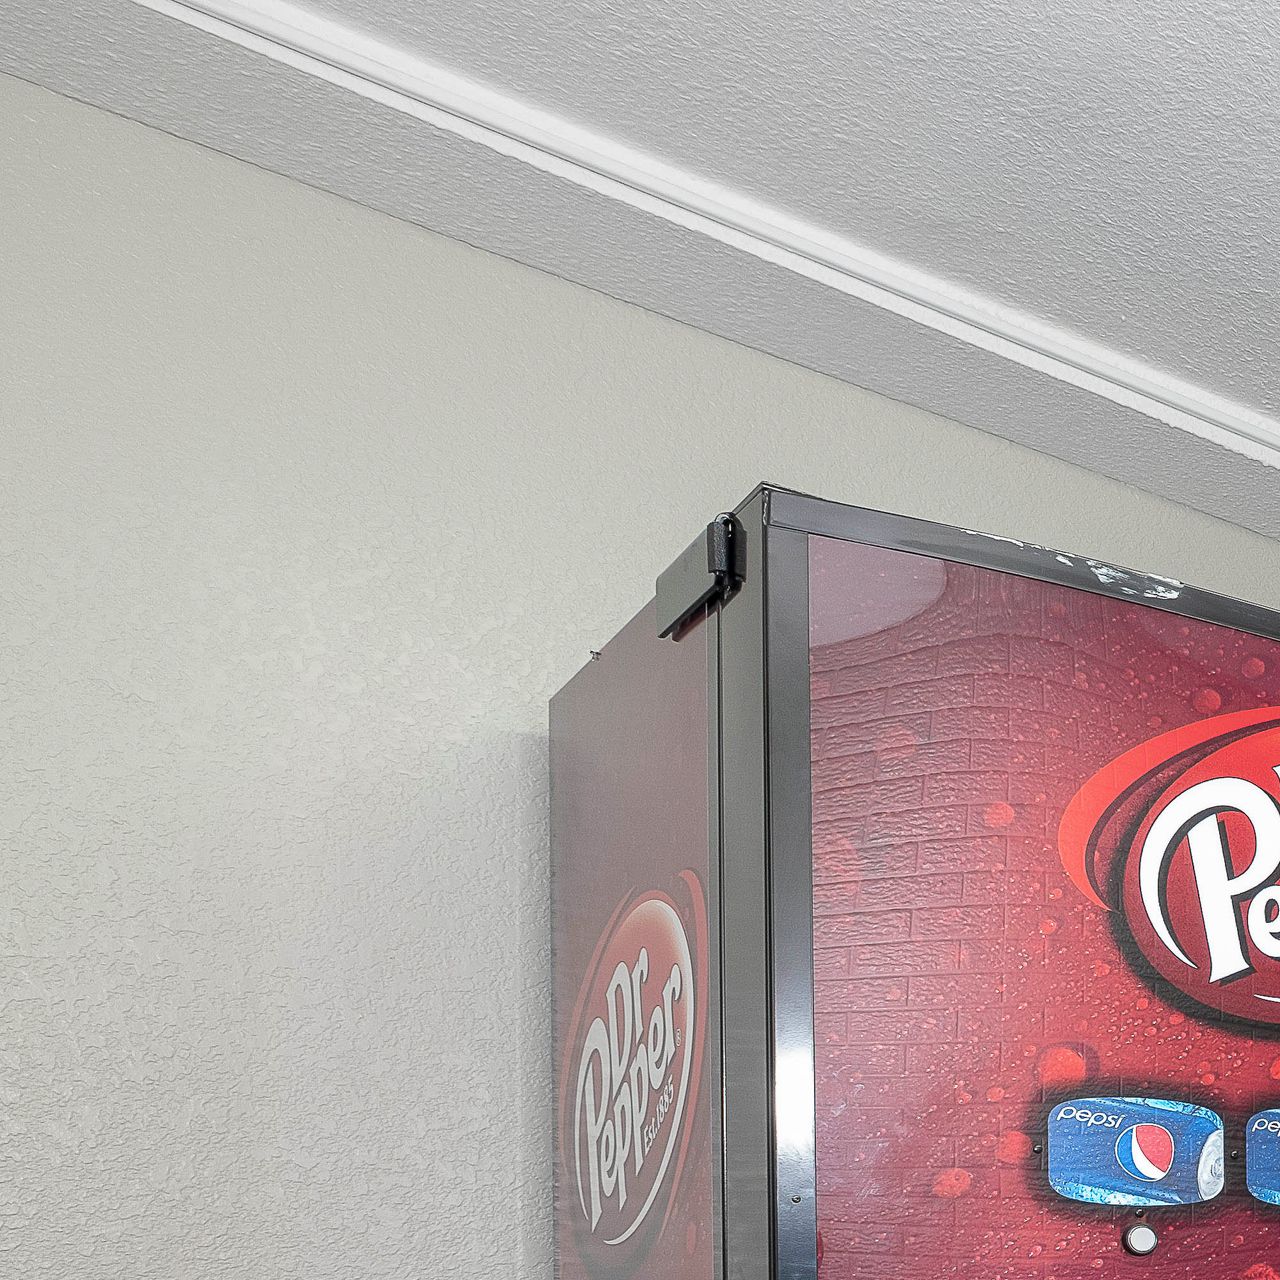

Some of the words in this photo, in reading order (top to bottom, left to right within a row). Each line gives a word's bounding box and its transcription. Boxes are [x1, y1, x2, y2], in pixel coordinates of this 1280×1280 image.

[574, 963, 682, 1234] Pepper
[605, 946, 649, 1101] Dr
[1056, 1106, 1127, 1129] pepsi
